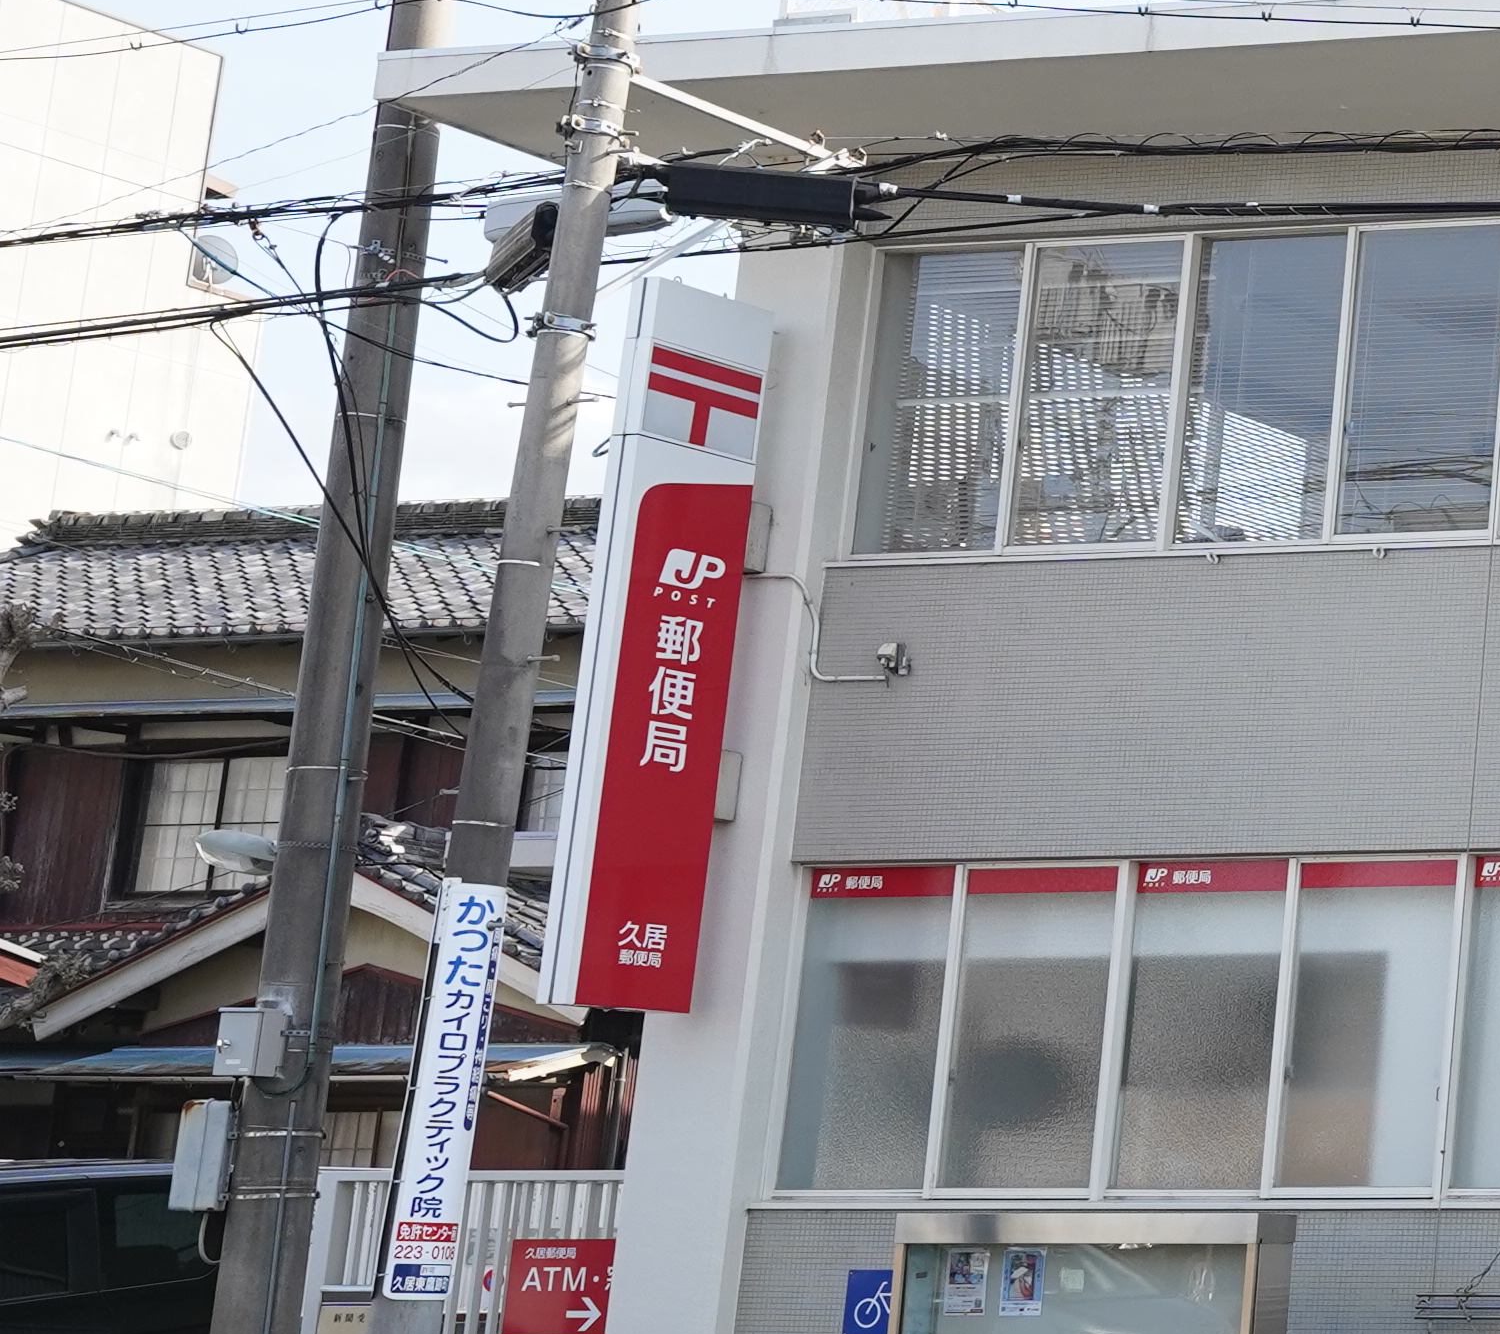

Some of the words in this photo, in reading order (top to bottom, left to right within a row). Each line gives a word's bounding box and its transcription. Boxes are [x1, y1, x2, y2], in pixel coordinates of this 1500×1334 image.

[653, 586, 716, 610] POST
[638, 614, 705, 773] 郵便局
[845, 875, 883, 890] 郵便局
[1172, 869, 1212, 885] 郵便局
[617, 921, 668, 951] 久居
[617, 948, 662, 969] 郵便局
[410, 895, 495, 1218] かつたカイロプラクティック院
[525, 1247, 577, 1259] 久居郵便局
